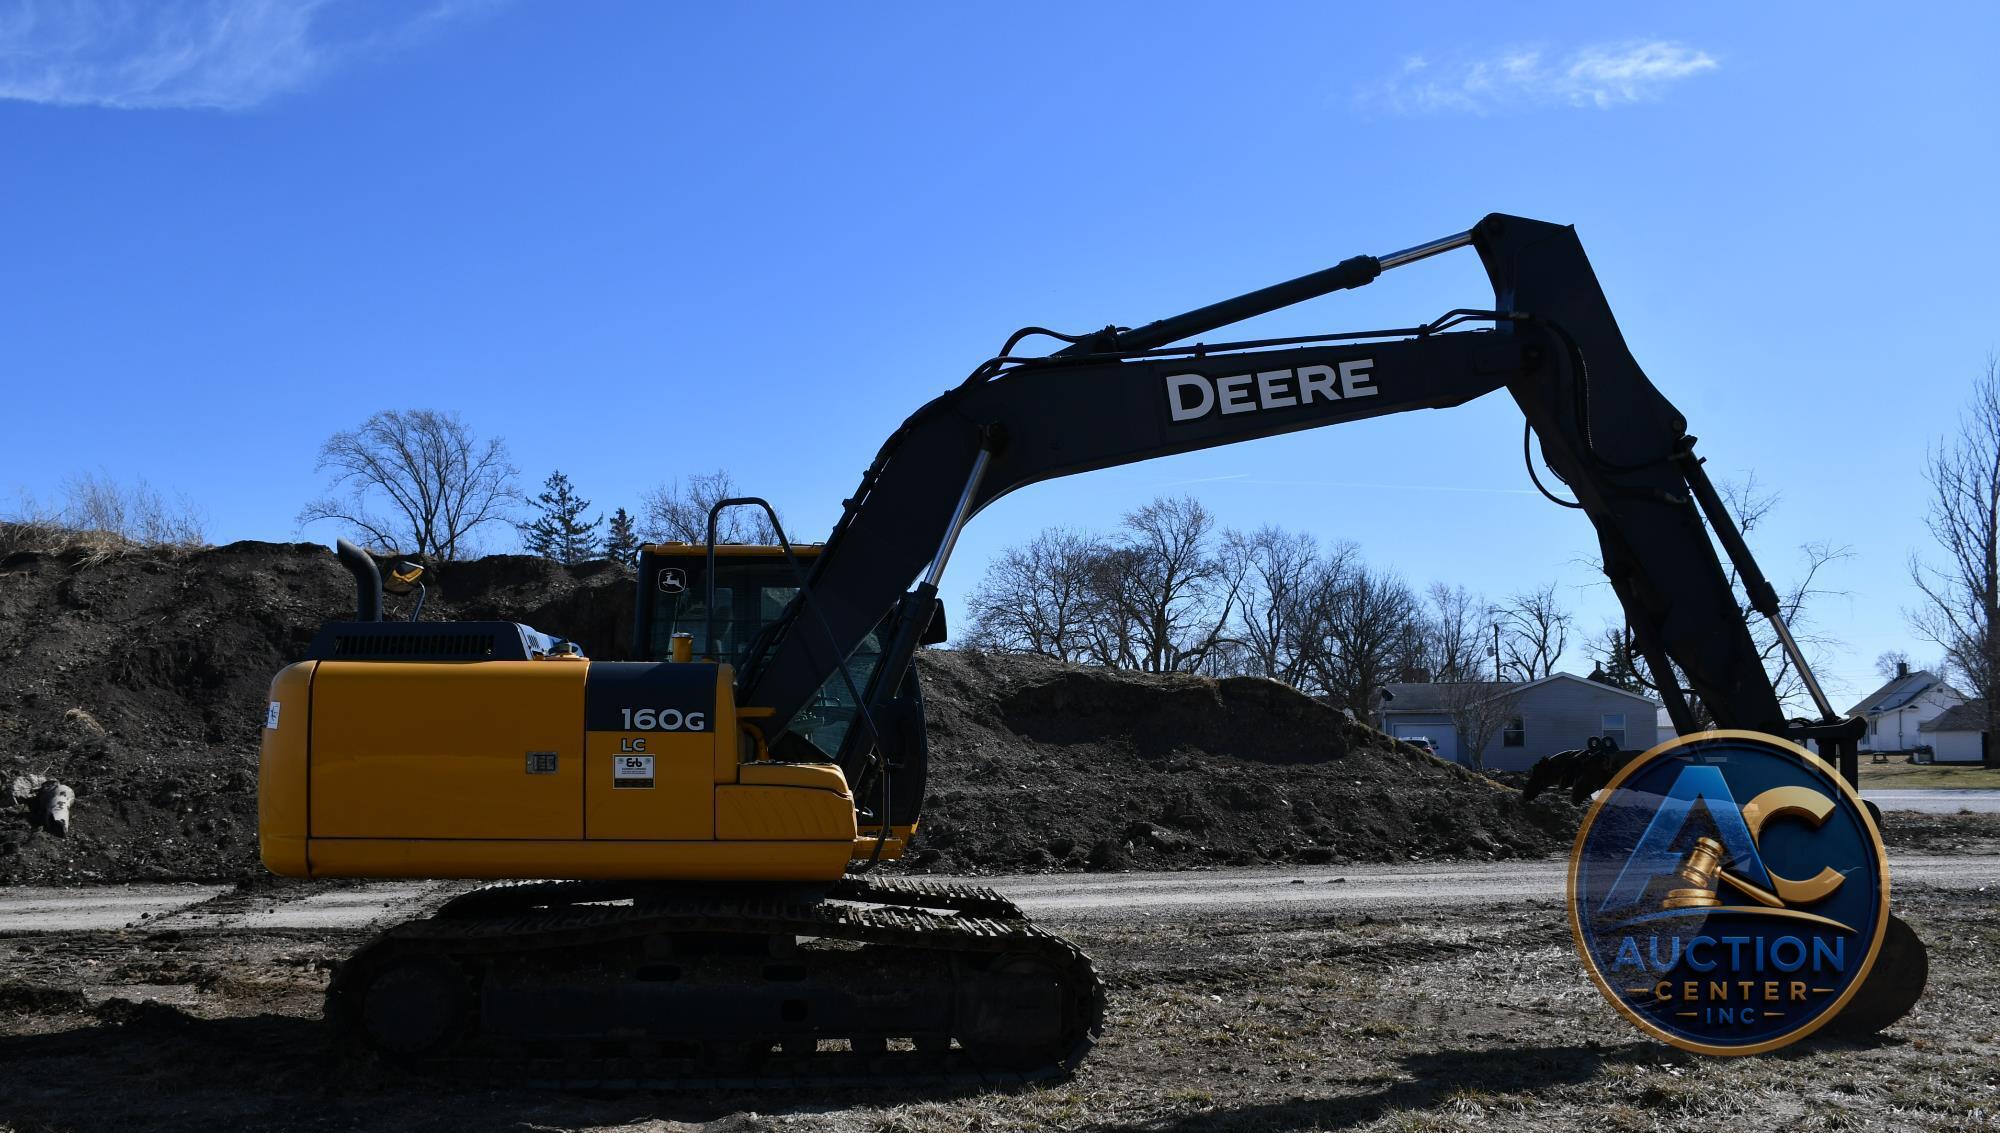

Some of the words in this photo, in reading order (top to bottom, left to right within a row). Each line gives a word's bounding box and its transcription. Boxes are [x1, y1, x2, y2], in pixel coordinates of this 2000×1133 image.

[1165, 358, 1379, 422] DEERE
[621, 708, 705, 731] 160G
[621, 738, 646, 752] LC
